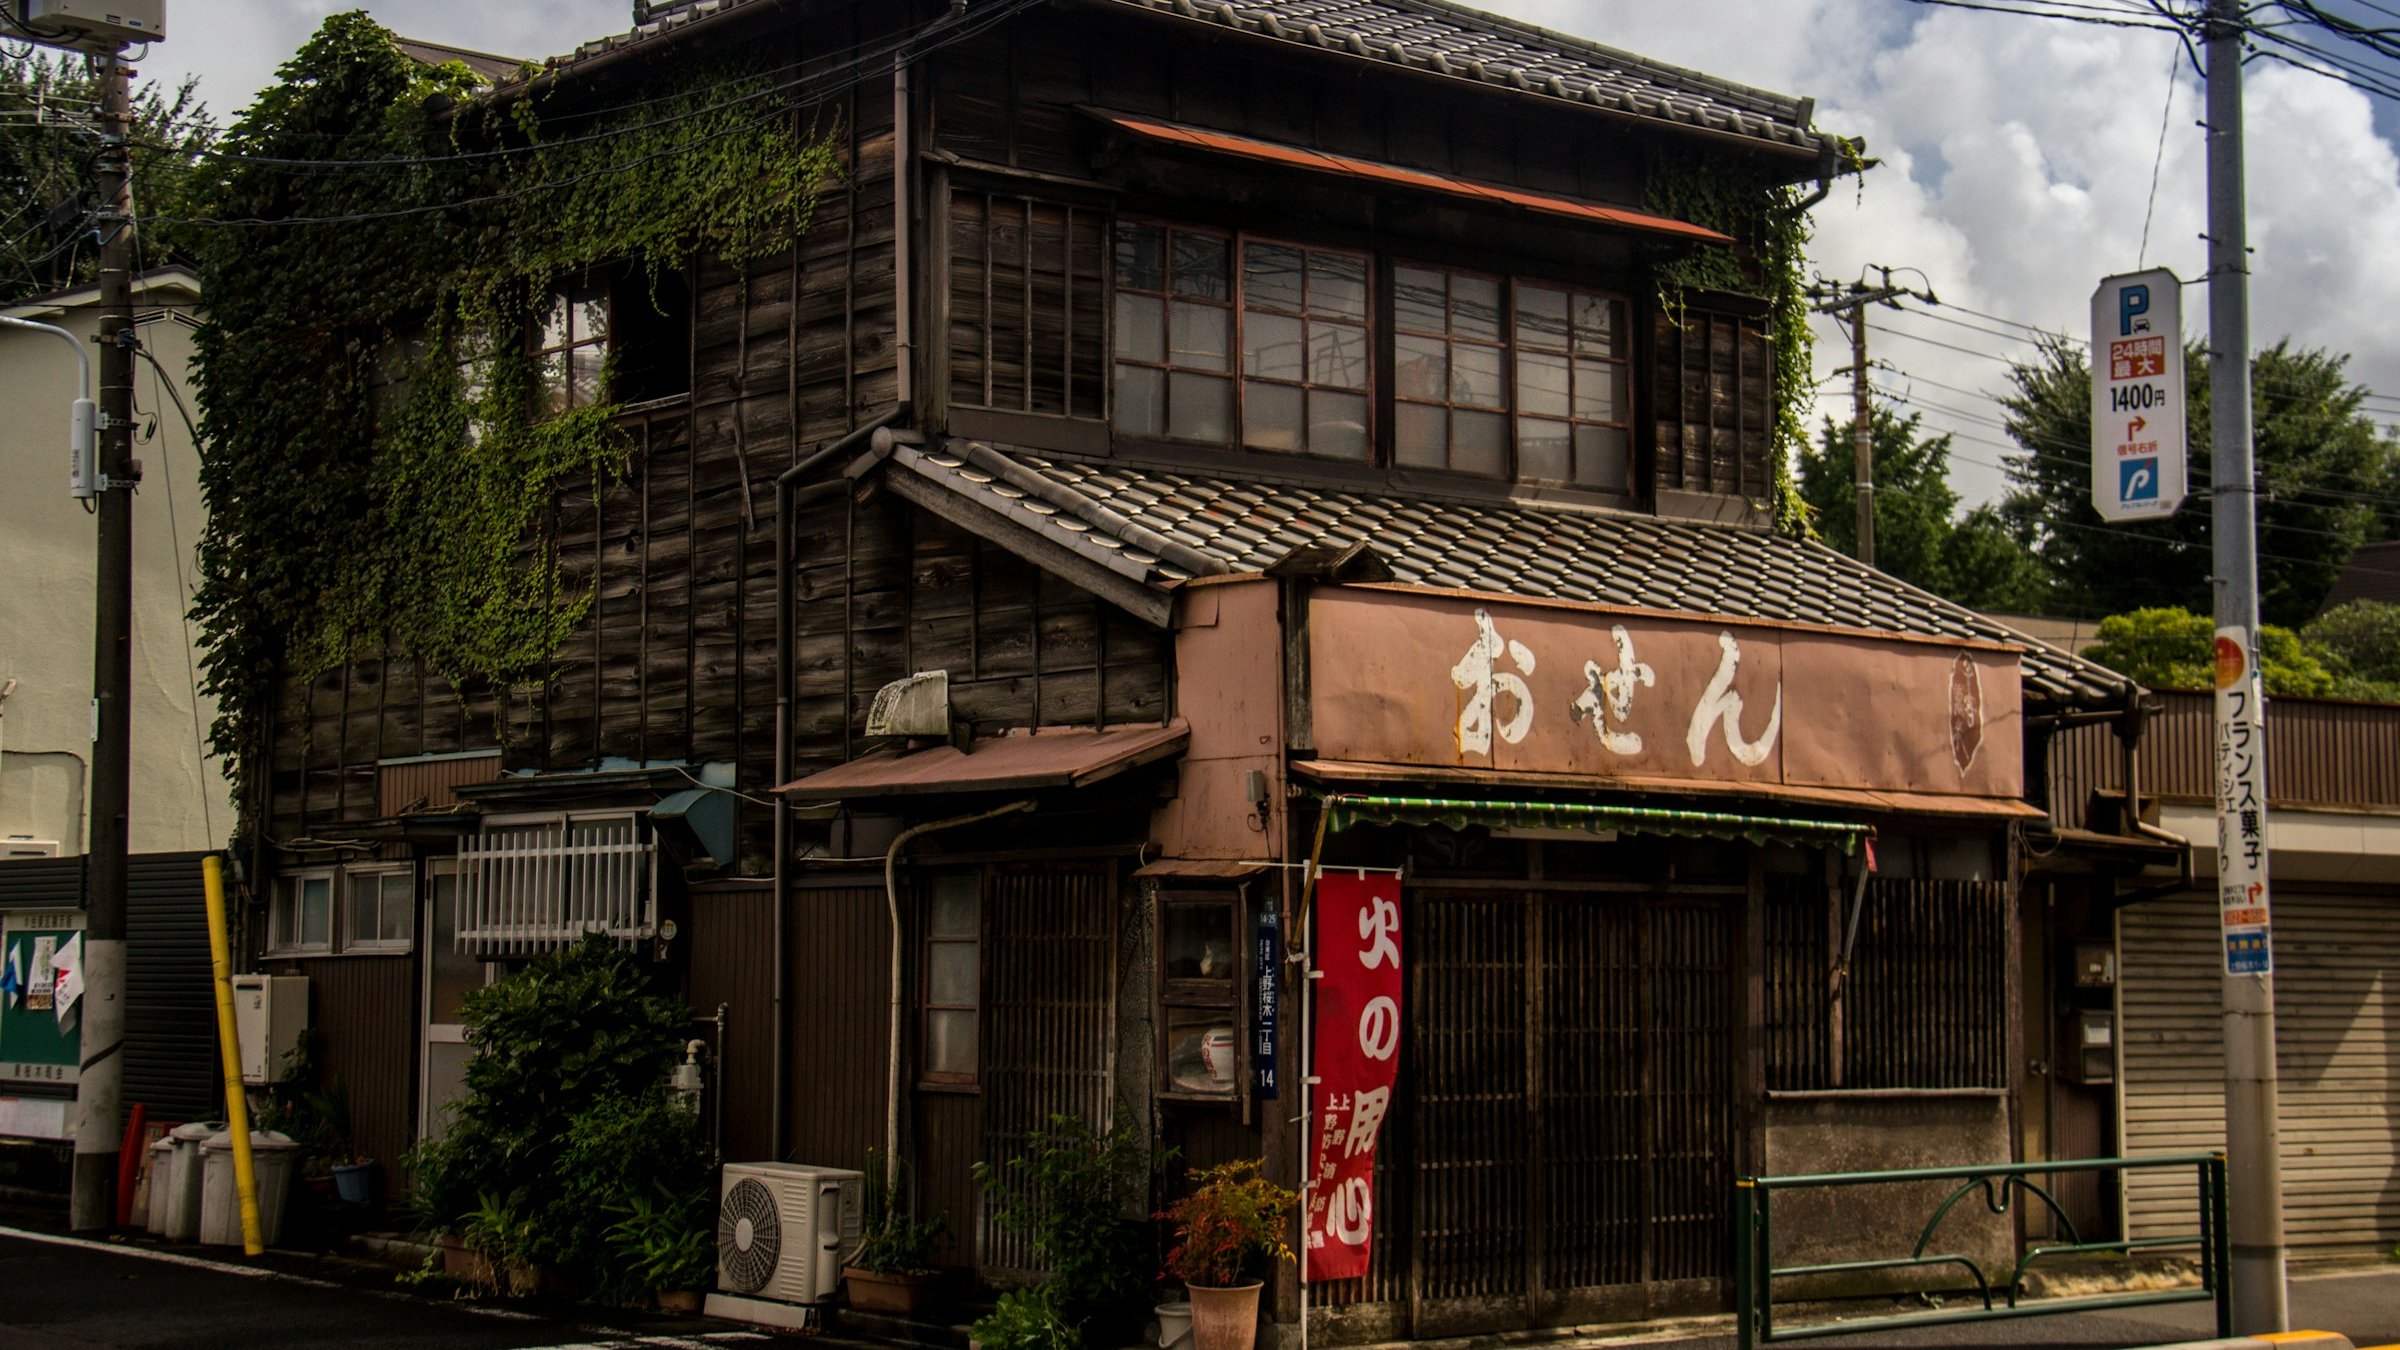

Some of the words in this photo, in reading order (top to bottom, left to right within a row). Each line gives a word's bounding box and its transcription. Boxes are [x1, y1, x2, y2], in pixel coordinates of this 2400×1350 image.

[2120, 284, 2149, 336] P
[2112, 338, 2162, 360] 24時間
[2114, 358, 2155, 378] 最大
[2111, 384, 2165, 411] 1400円
[2117, 441, 2159, 457] 信号右折
[1451, 608, 1781, 767] おせん
[2228, 692, 2262, 870] フランス菓子
[1262, 965, 1273, 1056] 上野桜木一丁目
[1260, 1068, 1274, 1088] 14
[1325, 896, 1400, 1247] 火の用心
